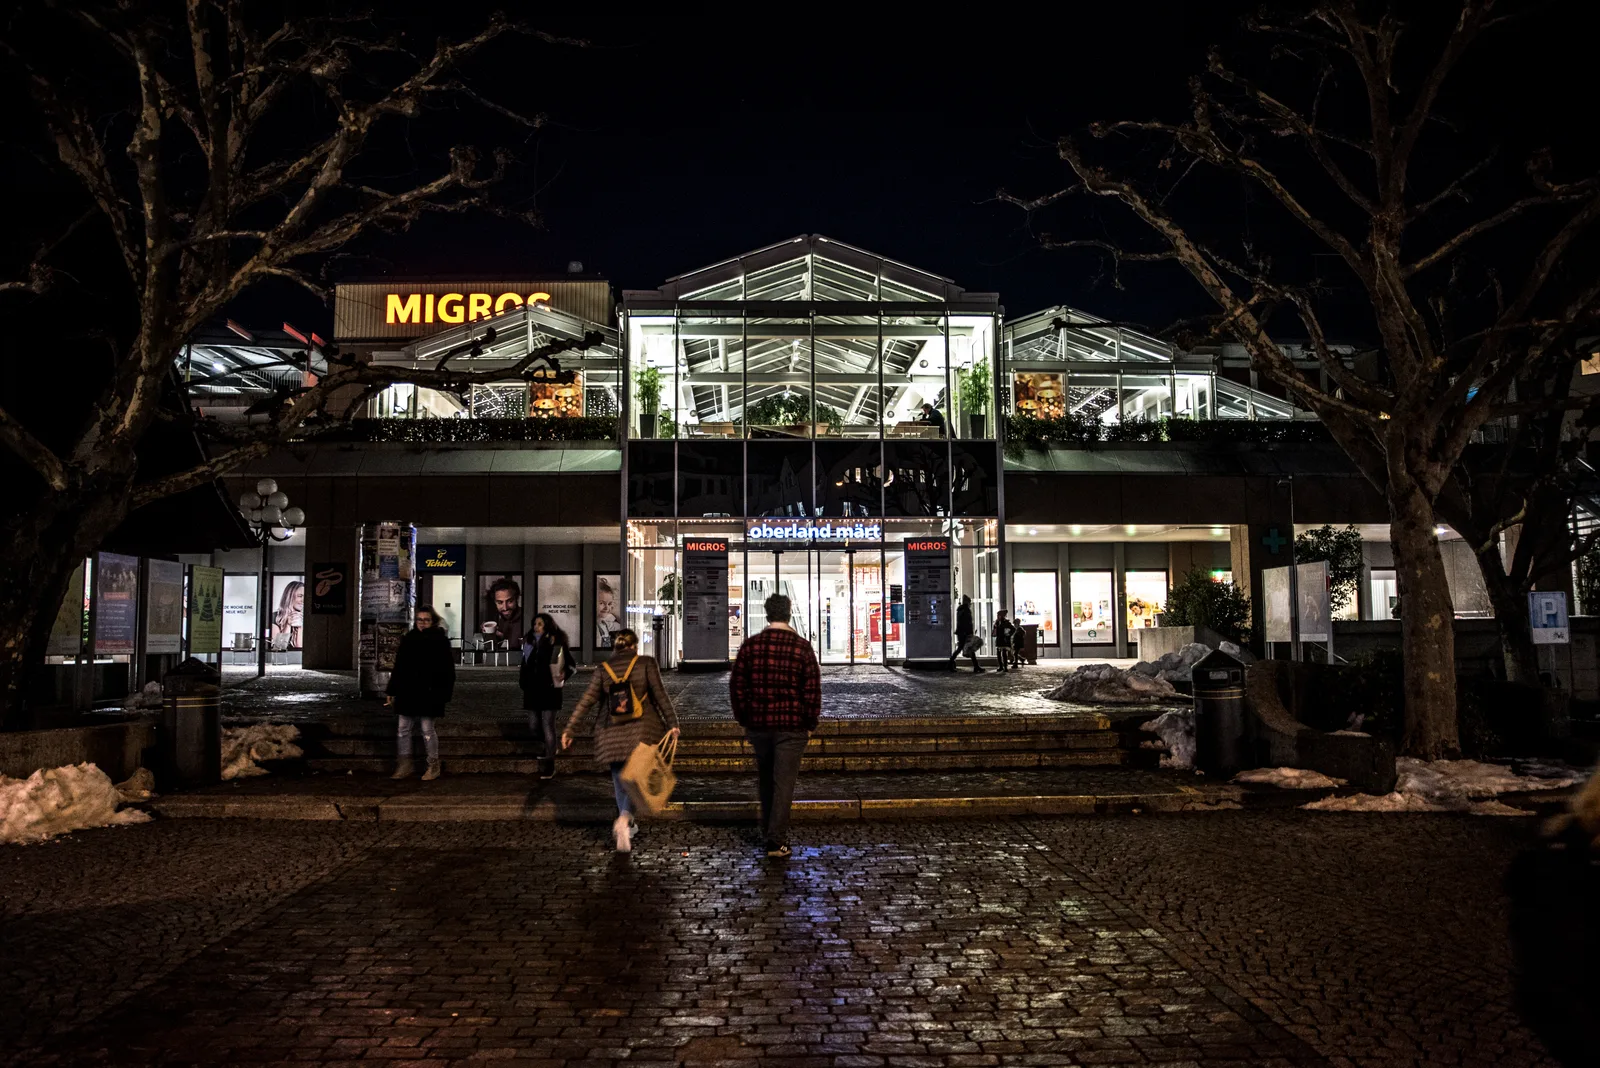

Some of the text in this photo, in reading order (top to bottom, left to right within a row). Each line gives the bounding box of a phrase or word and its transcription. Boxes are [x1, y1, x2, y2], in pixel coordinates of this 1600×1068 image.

[749, 523, 881, 539] oberland märt
[686, 542, 726, 552] MIGROS
[907, 541, 947, 551] MIGROS
[425, 559, 457, 568] Tchibo
[1541, 598, 1558, 625] P
